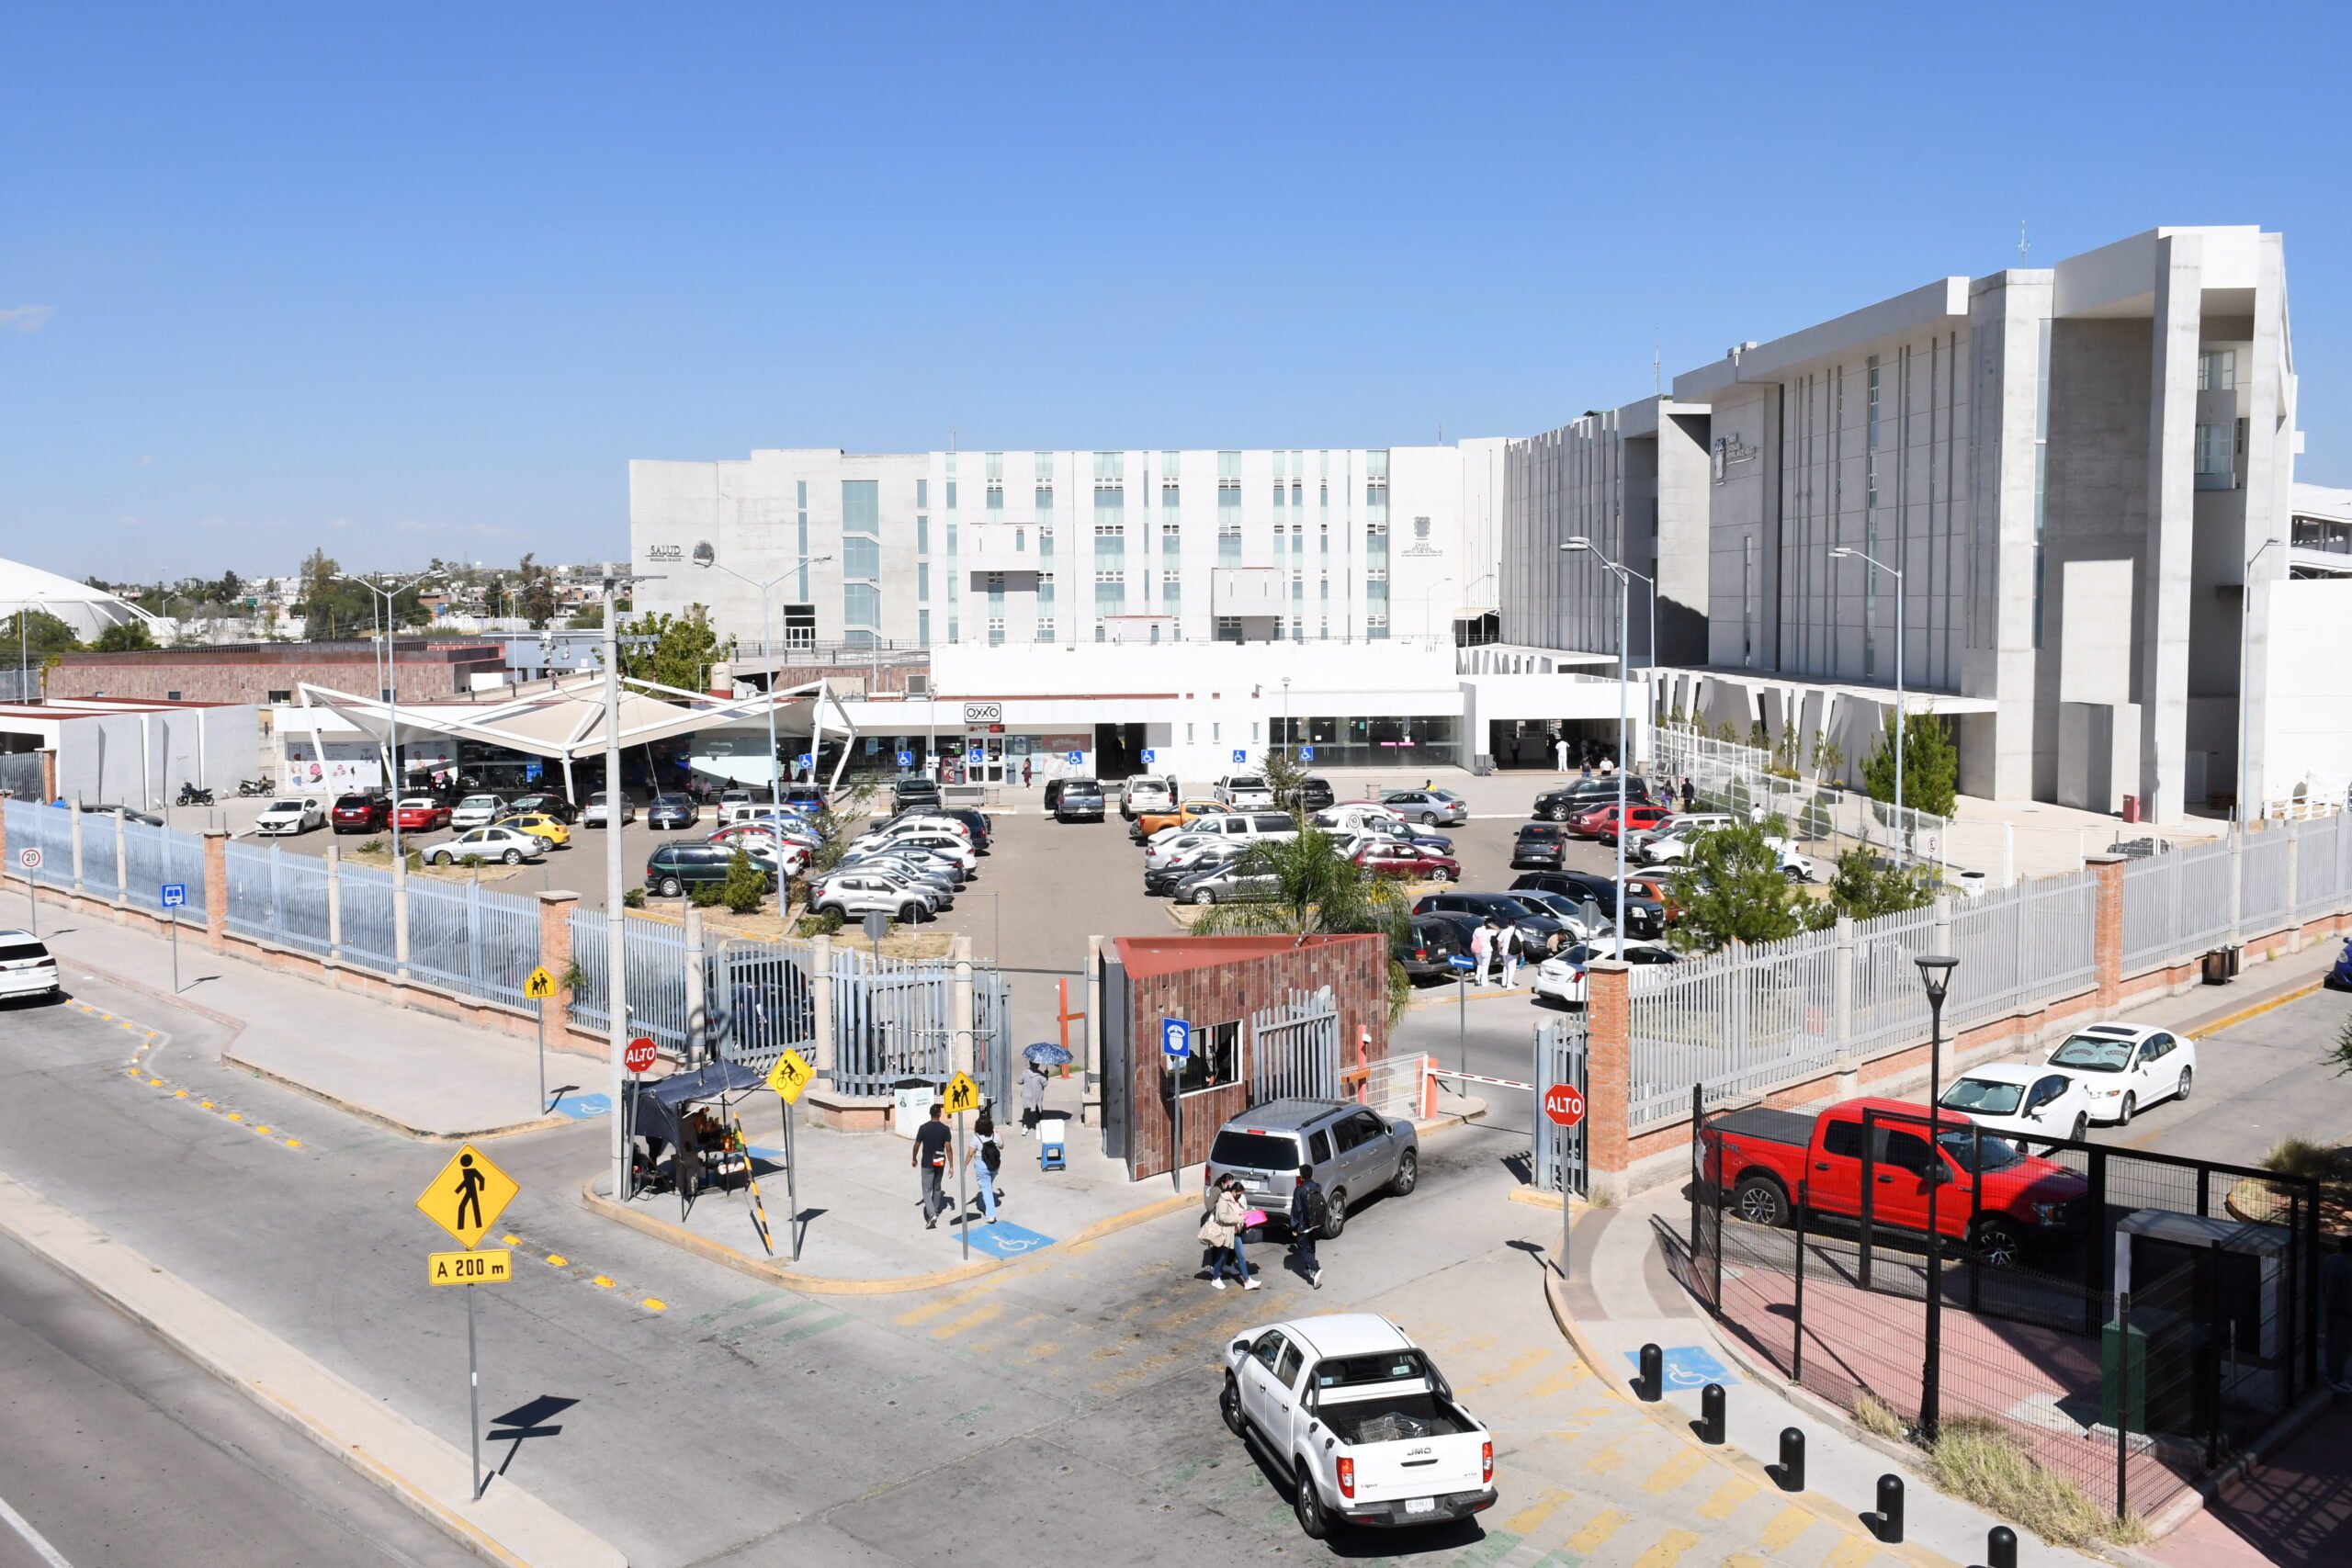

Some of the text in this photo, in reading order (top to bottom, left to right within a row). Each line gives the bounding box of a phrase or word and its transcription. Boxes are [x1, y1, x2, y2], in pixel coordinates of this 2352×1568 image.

[650, 545, 682, 556] SALUD
[967, 706, 999, 719] OXXO
[26, 852, 37, 862] 20
[626, 1046, 655, 1064] ALTO
[1546, 1095, 1582, 1115] ALTO
[436, 1258, 504, 1278] A 200 m
